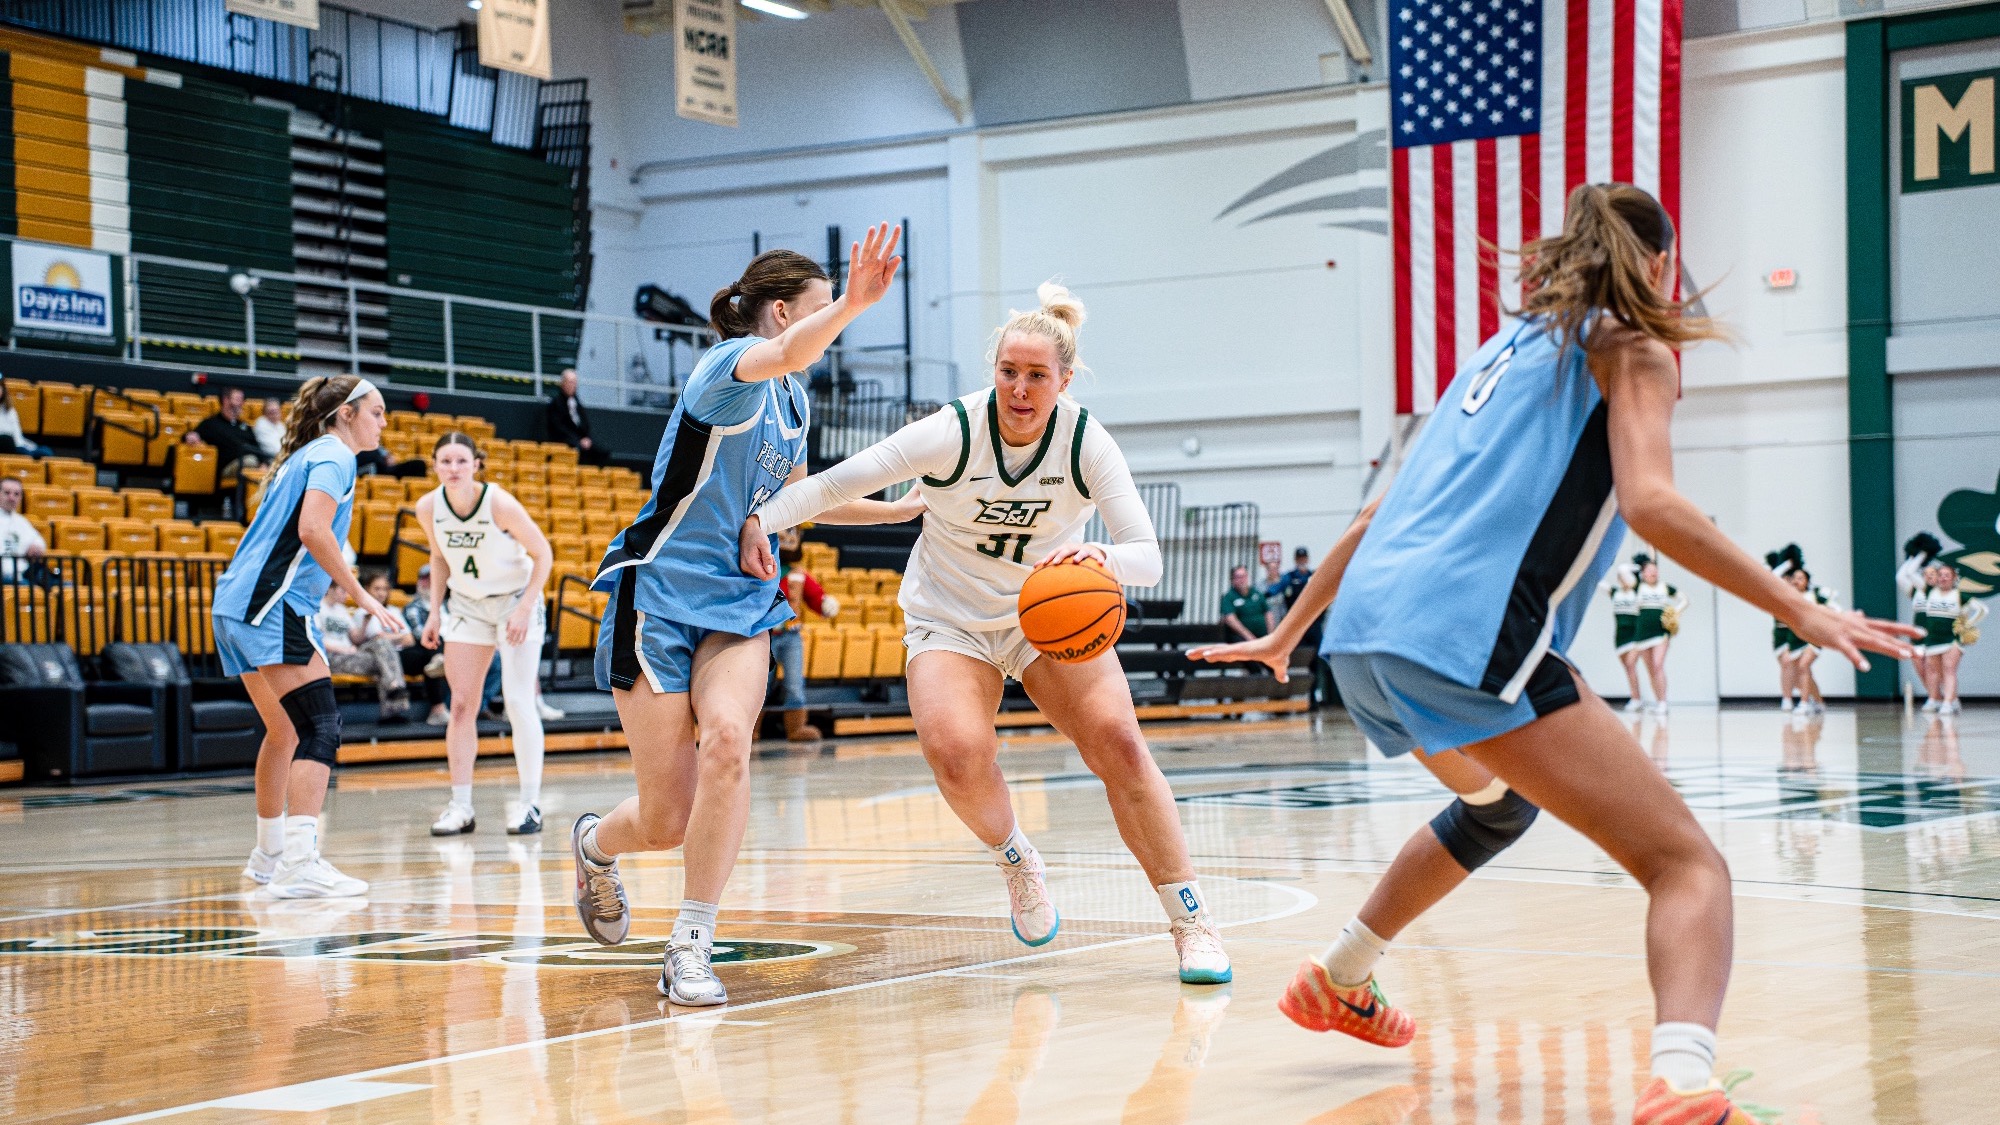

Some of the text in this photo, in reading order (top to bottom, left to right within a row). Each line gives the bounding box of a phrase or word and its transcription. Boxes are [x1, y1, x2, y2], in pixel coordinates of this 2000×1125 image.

[1914, 77, 1994, 181] M
[21, 287, 104, 315] Days Inn
[974, 498, 1052, 527] S&T
[463, 555, 478, 578] 4
